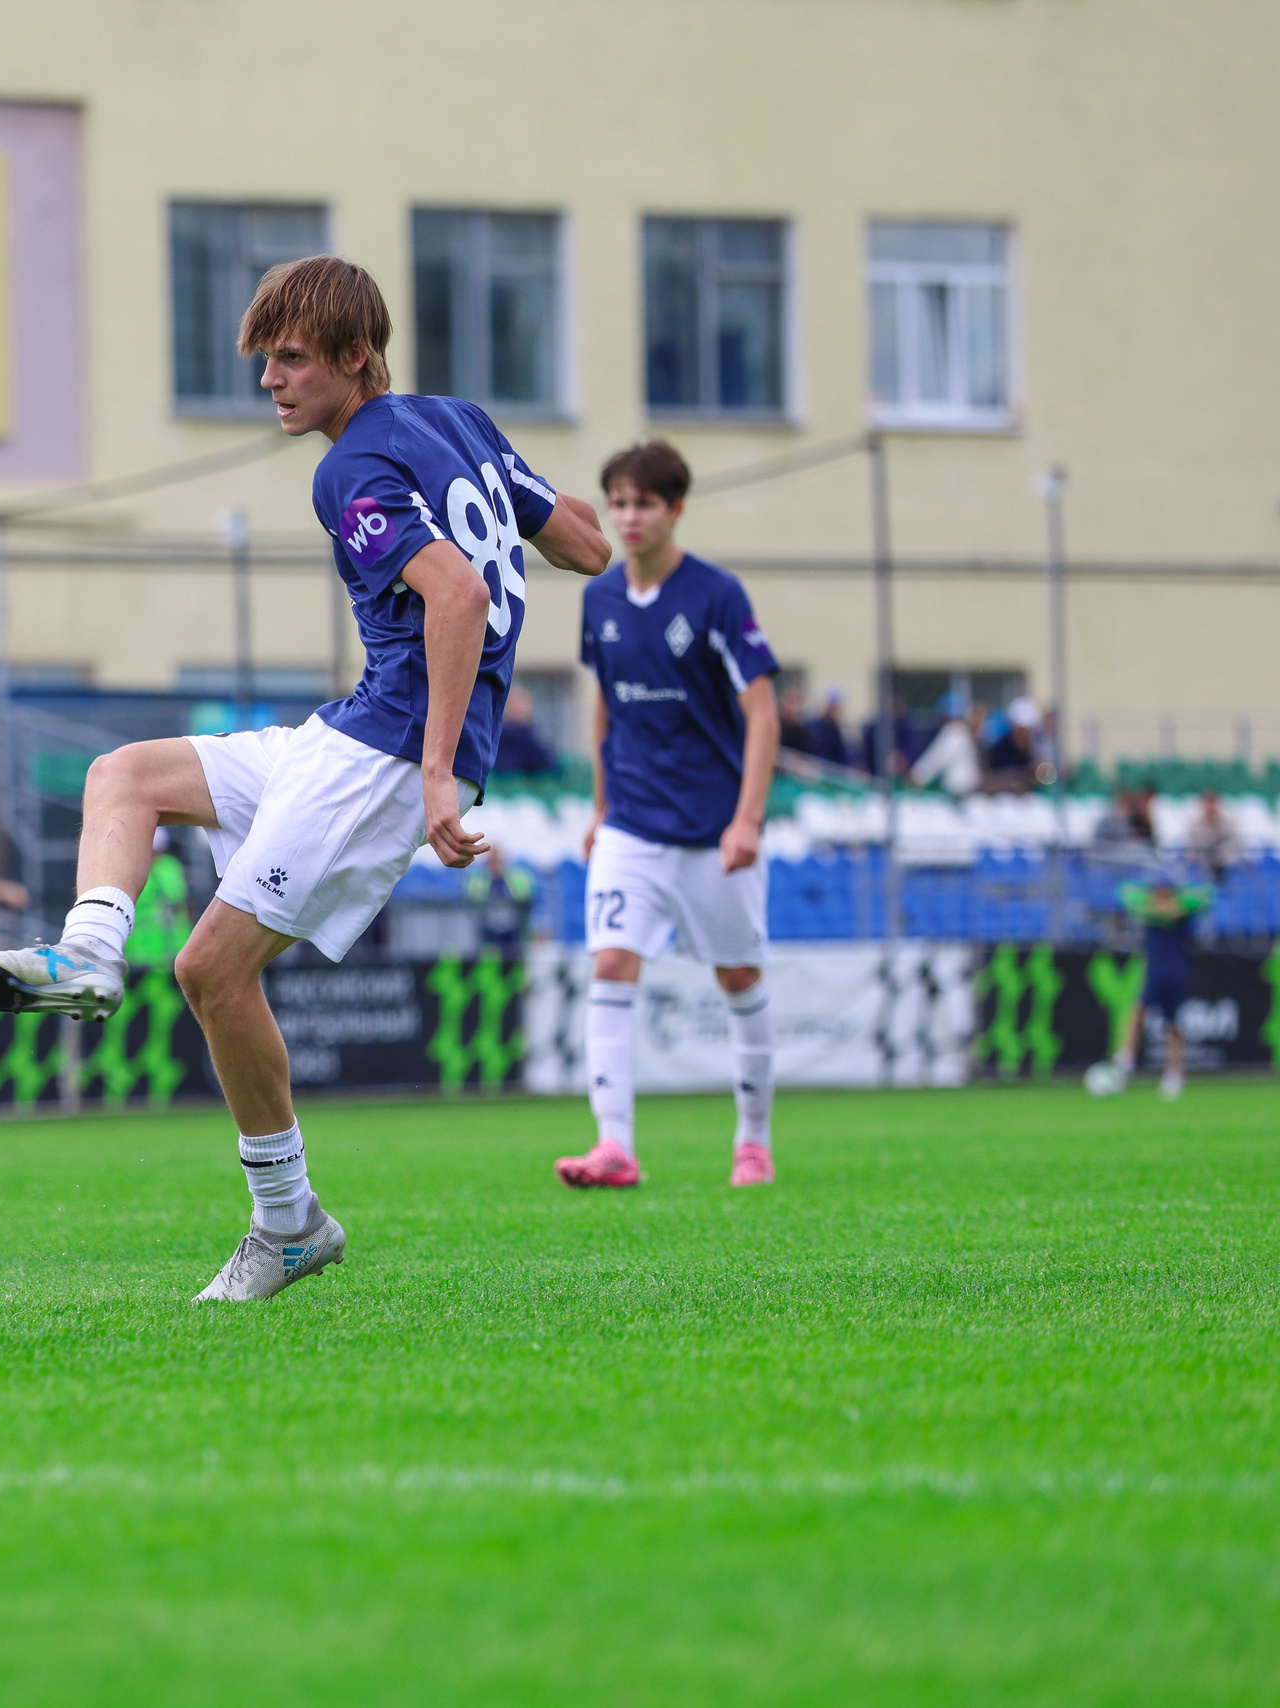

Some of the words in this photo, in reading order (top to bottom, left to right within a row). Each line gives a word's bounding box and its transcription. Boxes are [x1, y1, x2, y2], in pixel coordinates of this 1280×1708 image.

[347, 511, 388, 545] wb
[255, 876, 286, 899] KELME
[593, 889, 626, 930] 72
[286, 1243, 318, 1283] adidas
